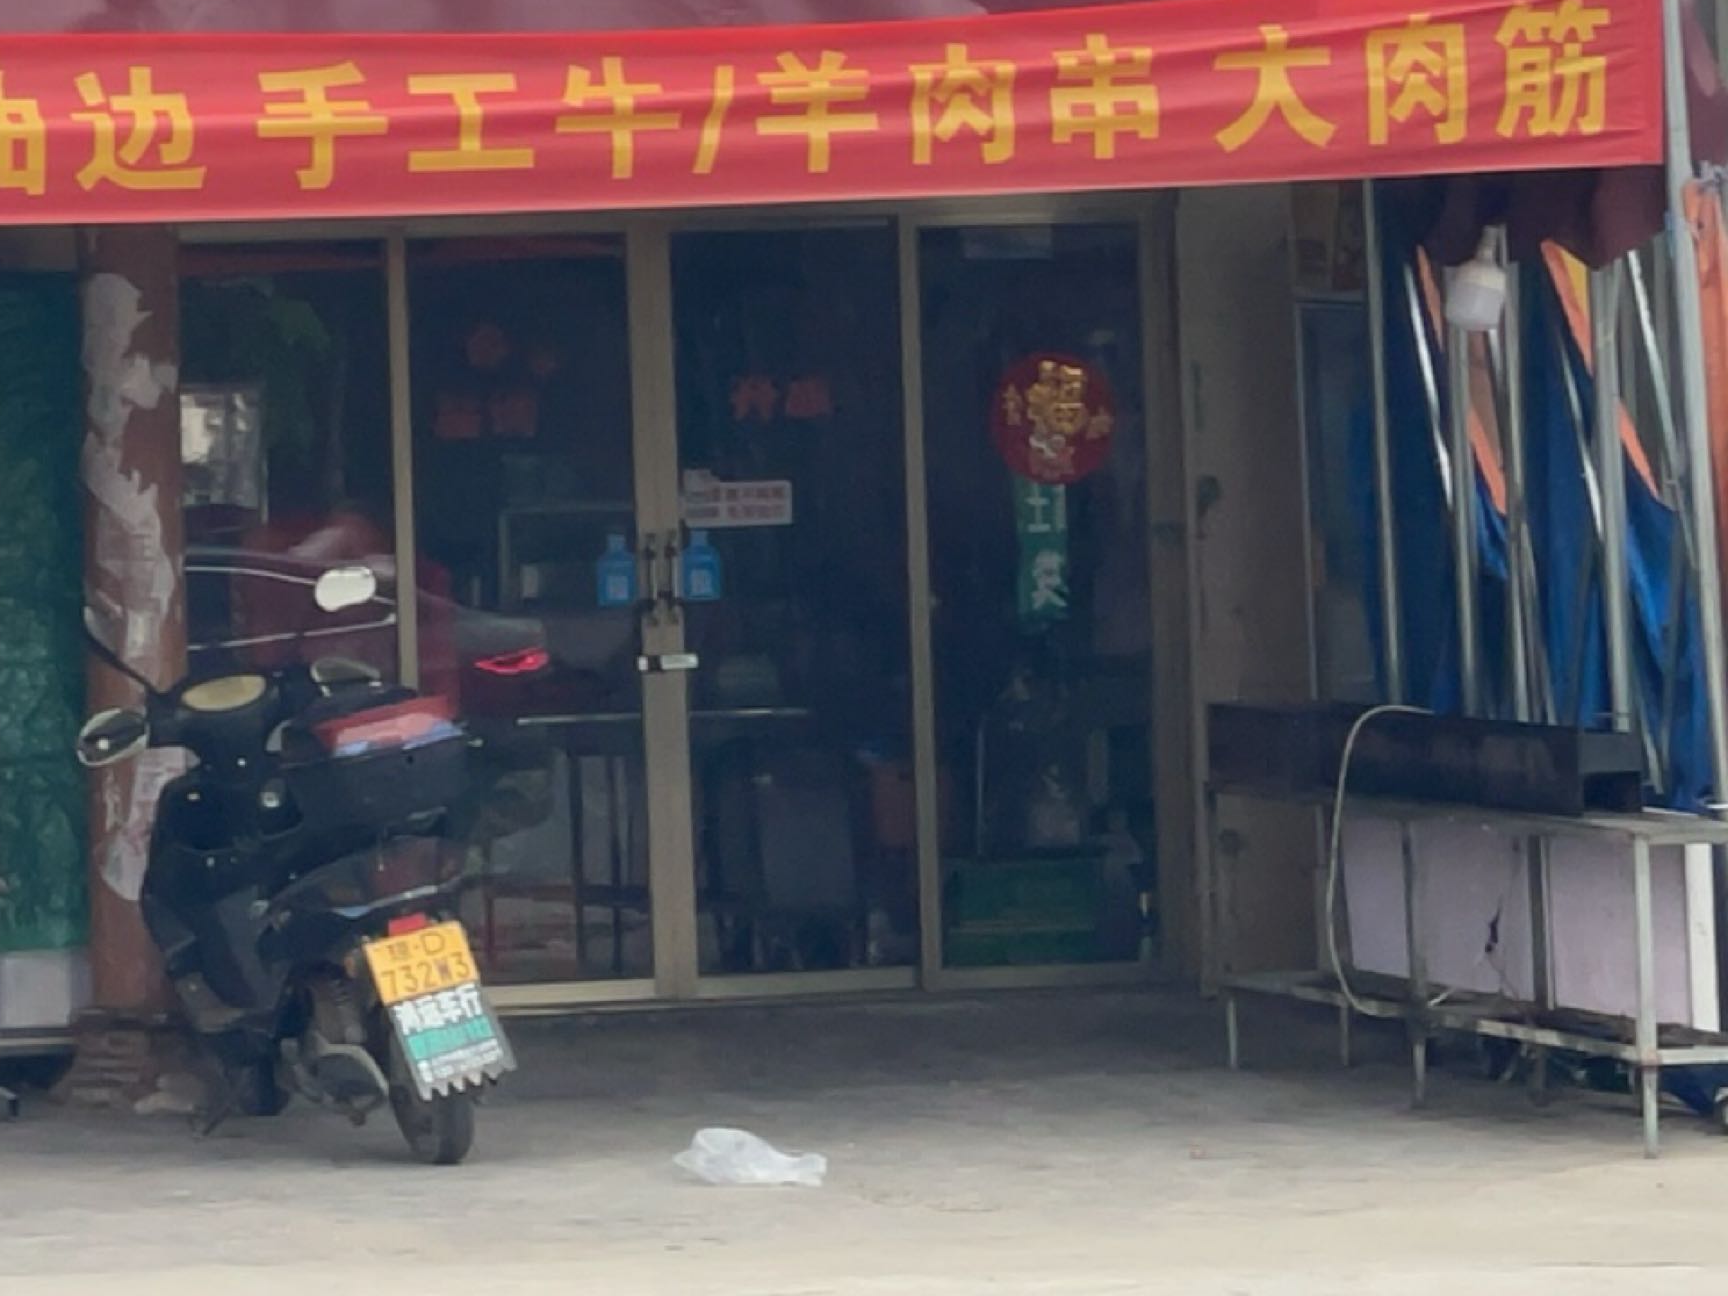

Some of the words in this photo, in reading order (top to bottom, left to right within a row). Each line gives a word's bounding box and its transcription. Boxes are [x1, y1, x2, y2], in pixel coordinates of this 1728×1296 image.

[254, 31, 1161, 190] 手工牛/羊肉串
